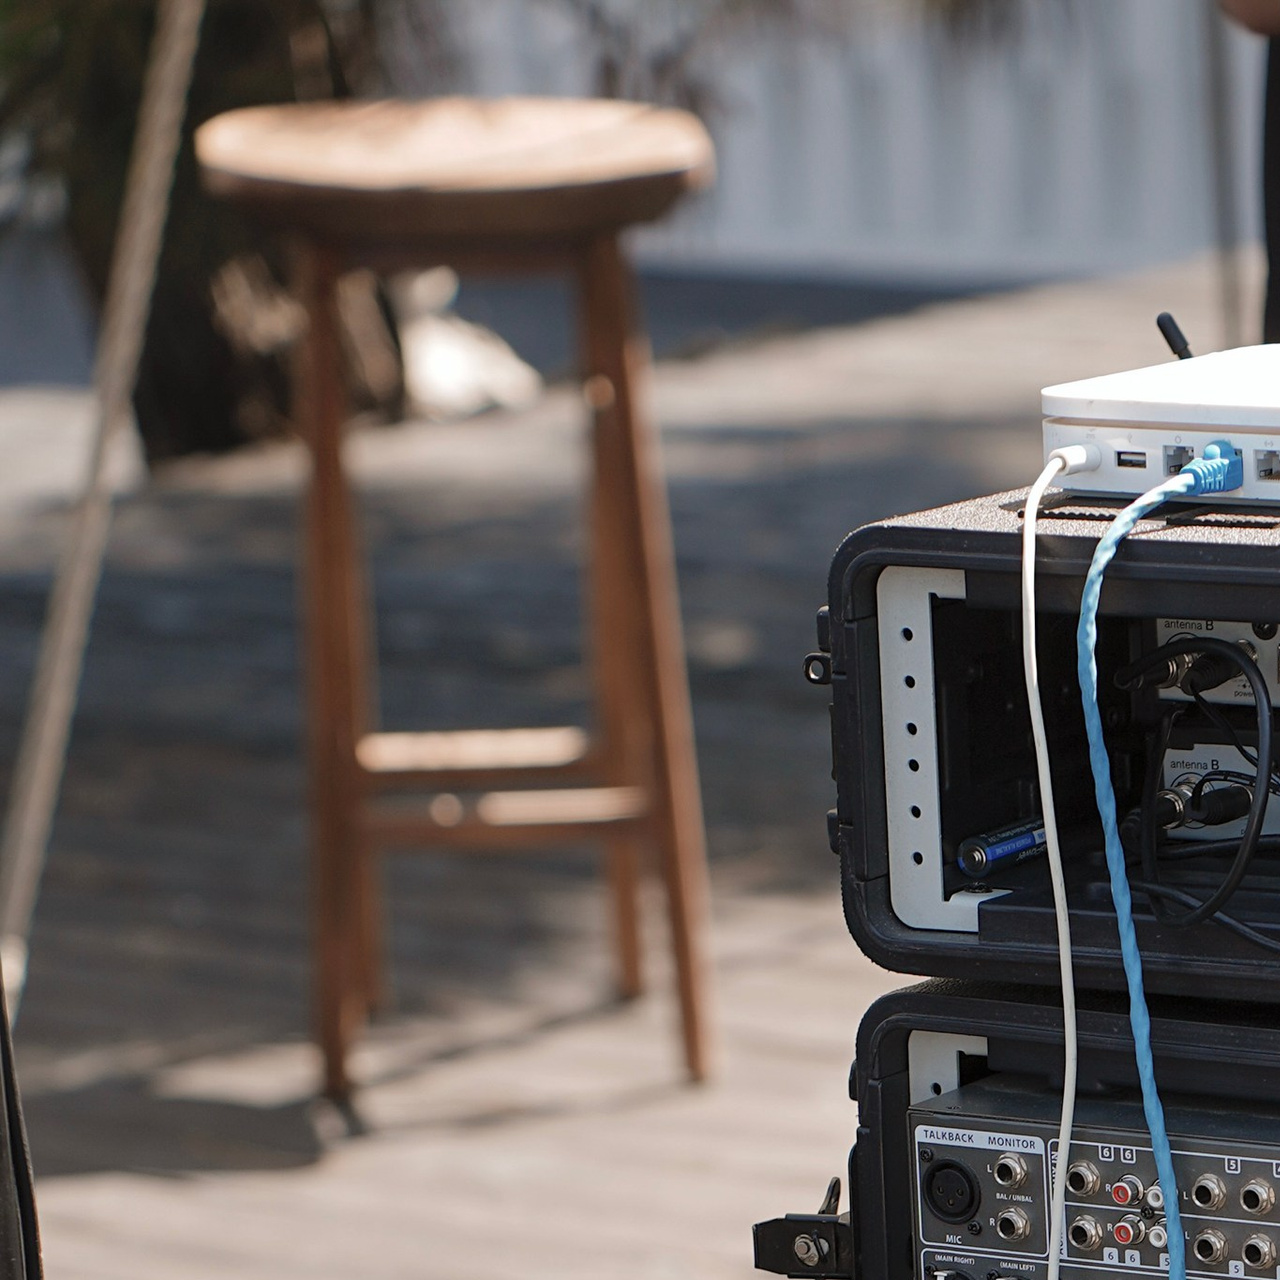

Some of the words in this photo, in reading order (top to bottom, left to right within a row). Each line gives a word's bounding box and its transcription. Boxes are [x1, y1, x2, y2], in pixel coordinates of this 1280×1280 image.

[1164, 619, 1202, 630] antenna
[1205, 619, 1214, 631] B
[1170, 760, 1207, 770] antenna
[1211, 760, 1219, 770] B
[923, 1129, 974, 1143] TALKBACK
[988, 1136, 1036, 1150] MONITOR
[987, 1164, 992, 1173] L
[995, 1192, 1007, 1201] BAL
[1012, 1194, 1033, 1203] UNBAL
[989, 1218, 995, 1227] R
[945, 1234, 962, 1245] MIC
[935, 1253, 952, 1263] (MAIN
[953, 1255, 975, 1266] RIGHT)
[1000, 1260, 1018, 1271] (MAIN
[1019, 1263, 1036, 1272] LEFT)
